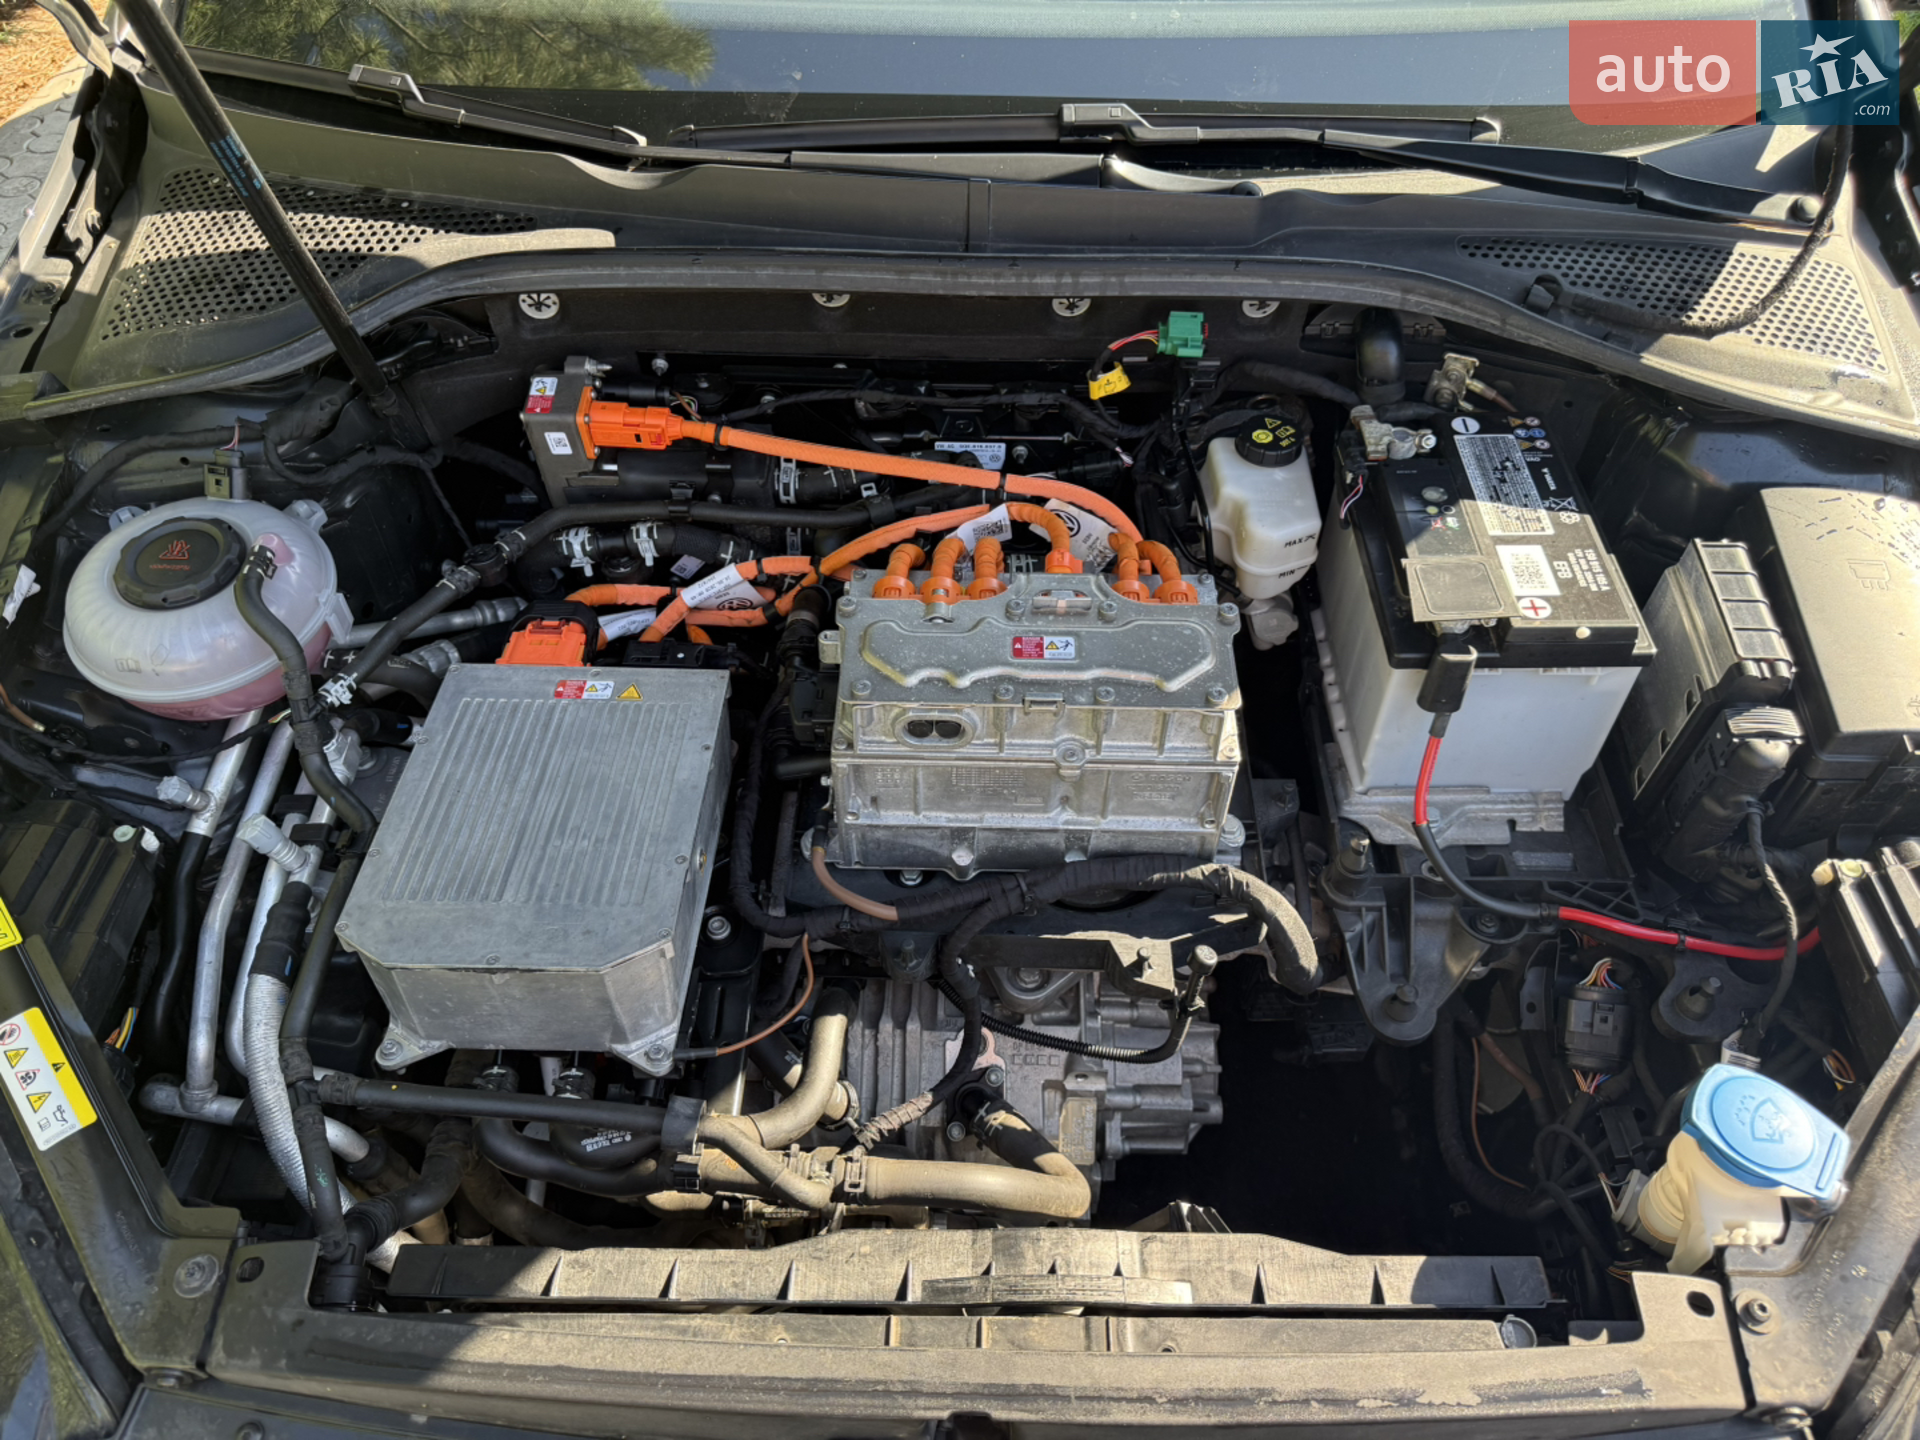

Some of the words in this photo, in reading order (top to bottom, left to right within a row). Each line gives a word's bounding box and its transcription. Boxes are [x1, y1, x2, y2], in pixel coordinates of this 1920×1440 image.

[1284, 537, 1304, 548] MAX
[1278, 569, 1296, 579] MIN
[1553, 560, 1573, 579] EFB
